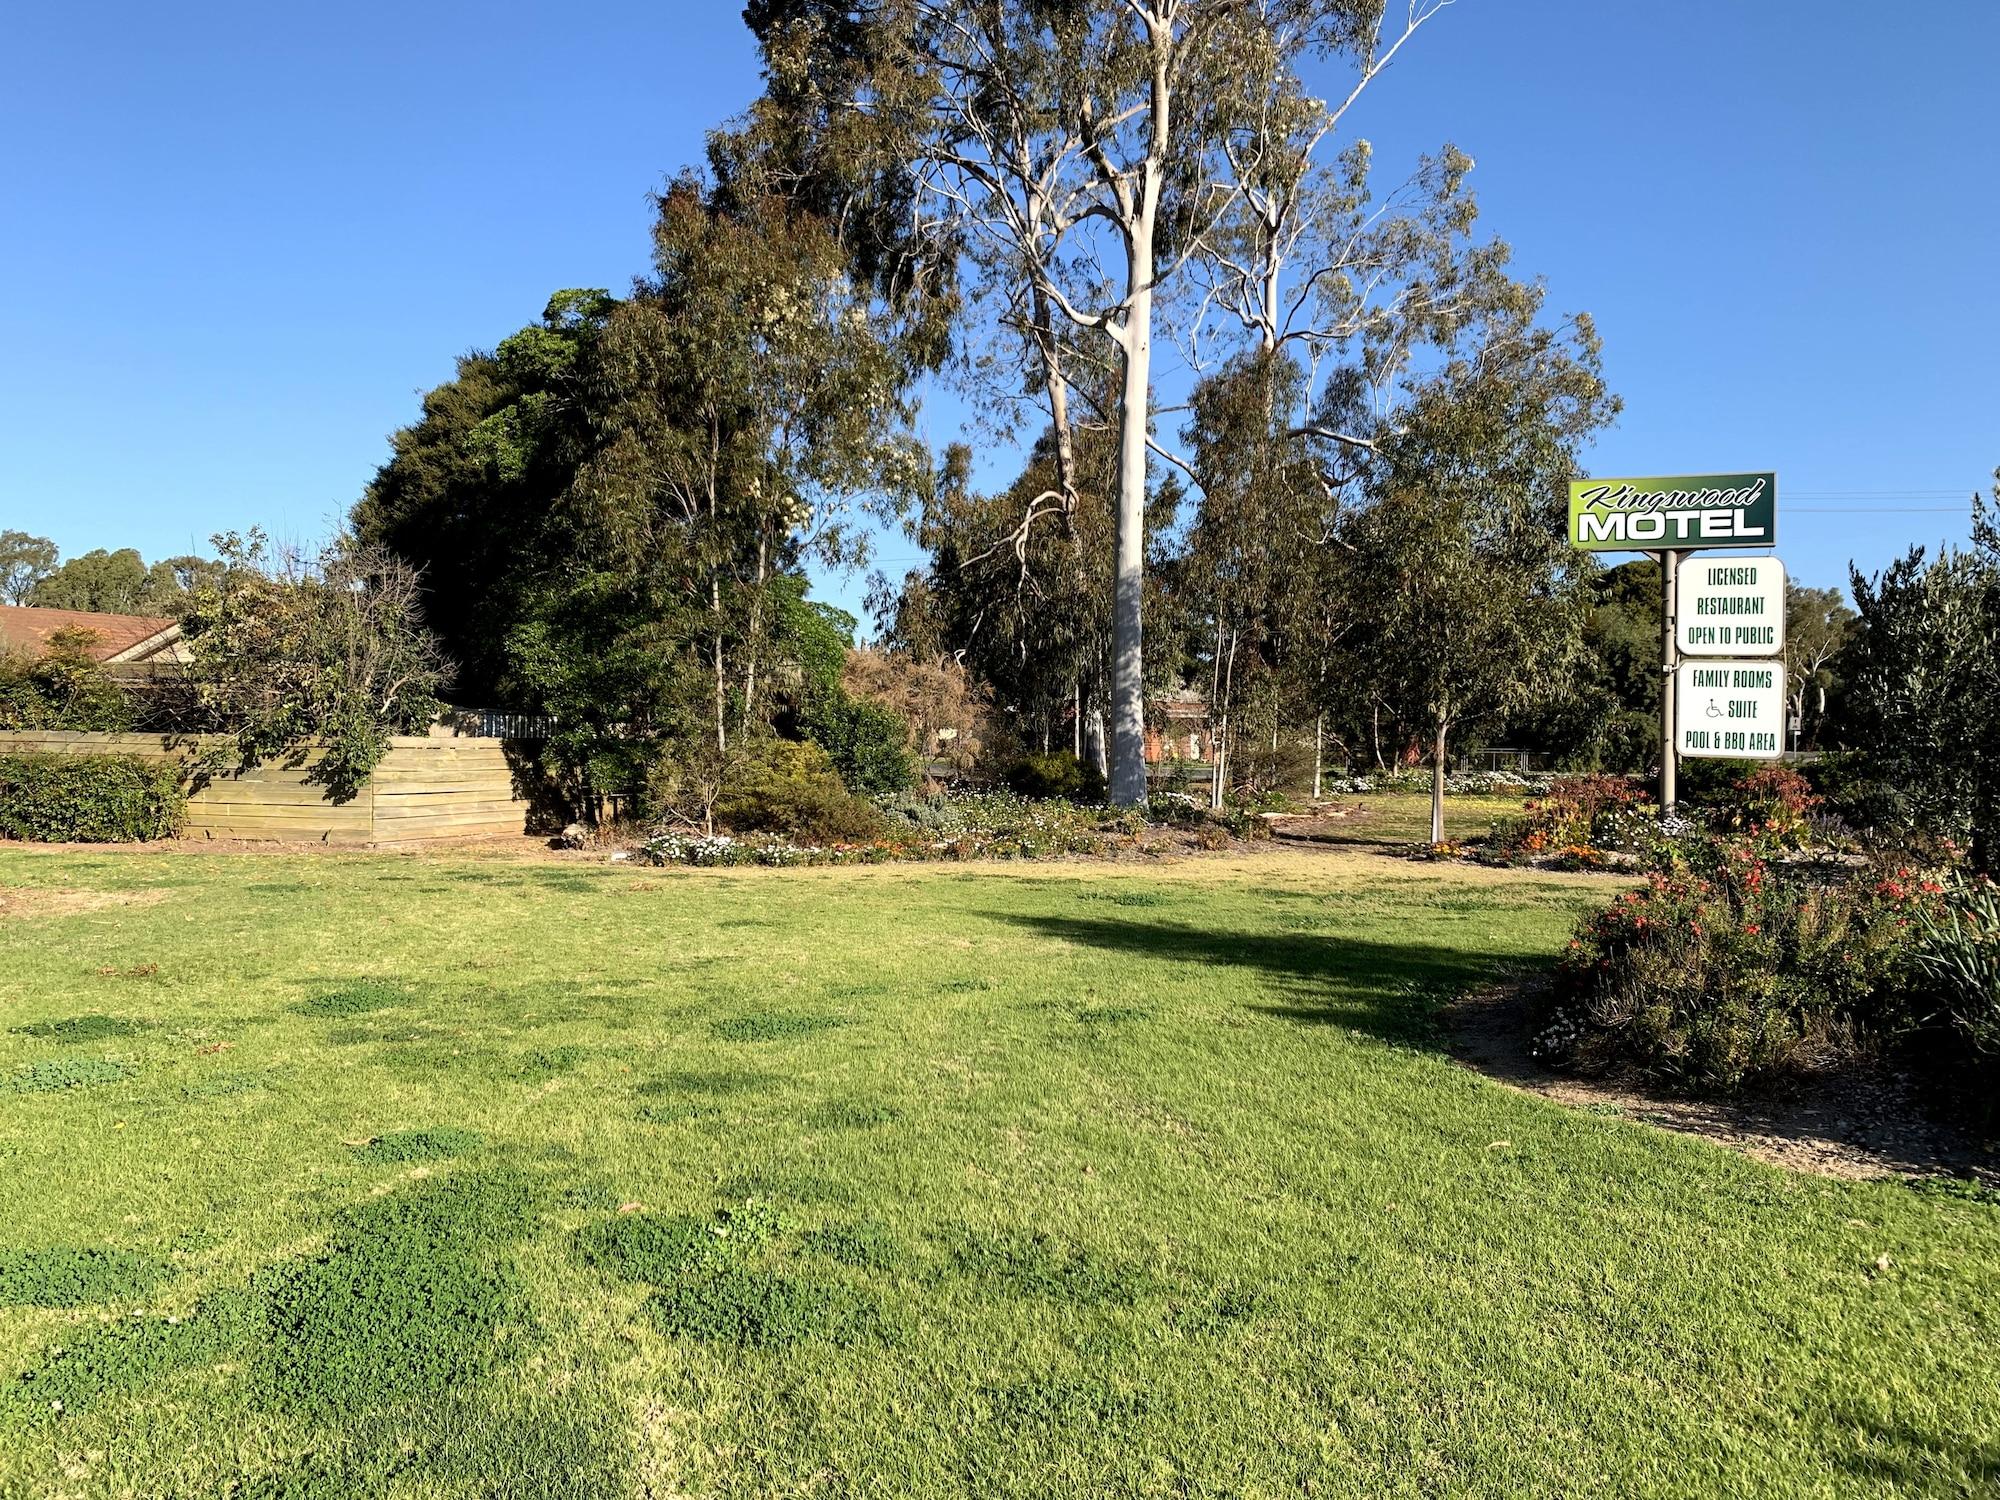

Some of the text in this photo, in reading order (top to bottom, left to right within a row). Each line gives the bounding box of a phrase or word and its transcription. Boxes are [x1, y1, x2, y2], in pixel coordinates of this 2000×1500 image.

[1580, 477, 1766, 515] Kingswood
[1578, 508, 1765, 542] MOTEL
[1708, 567, 1757, 586] LICENSED
[1697, 597, 1765, 615] RESTAURANT
[1688, 626, 1774, 645] OPEN TO PUBLIC
[1693, 670, 1773, 689] FAMILY ROOMS
[1728, 700, 1758, 719] SUITE
[1686, 731, 1775, 751] POOL & BBQ AREA
